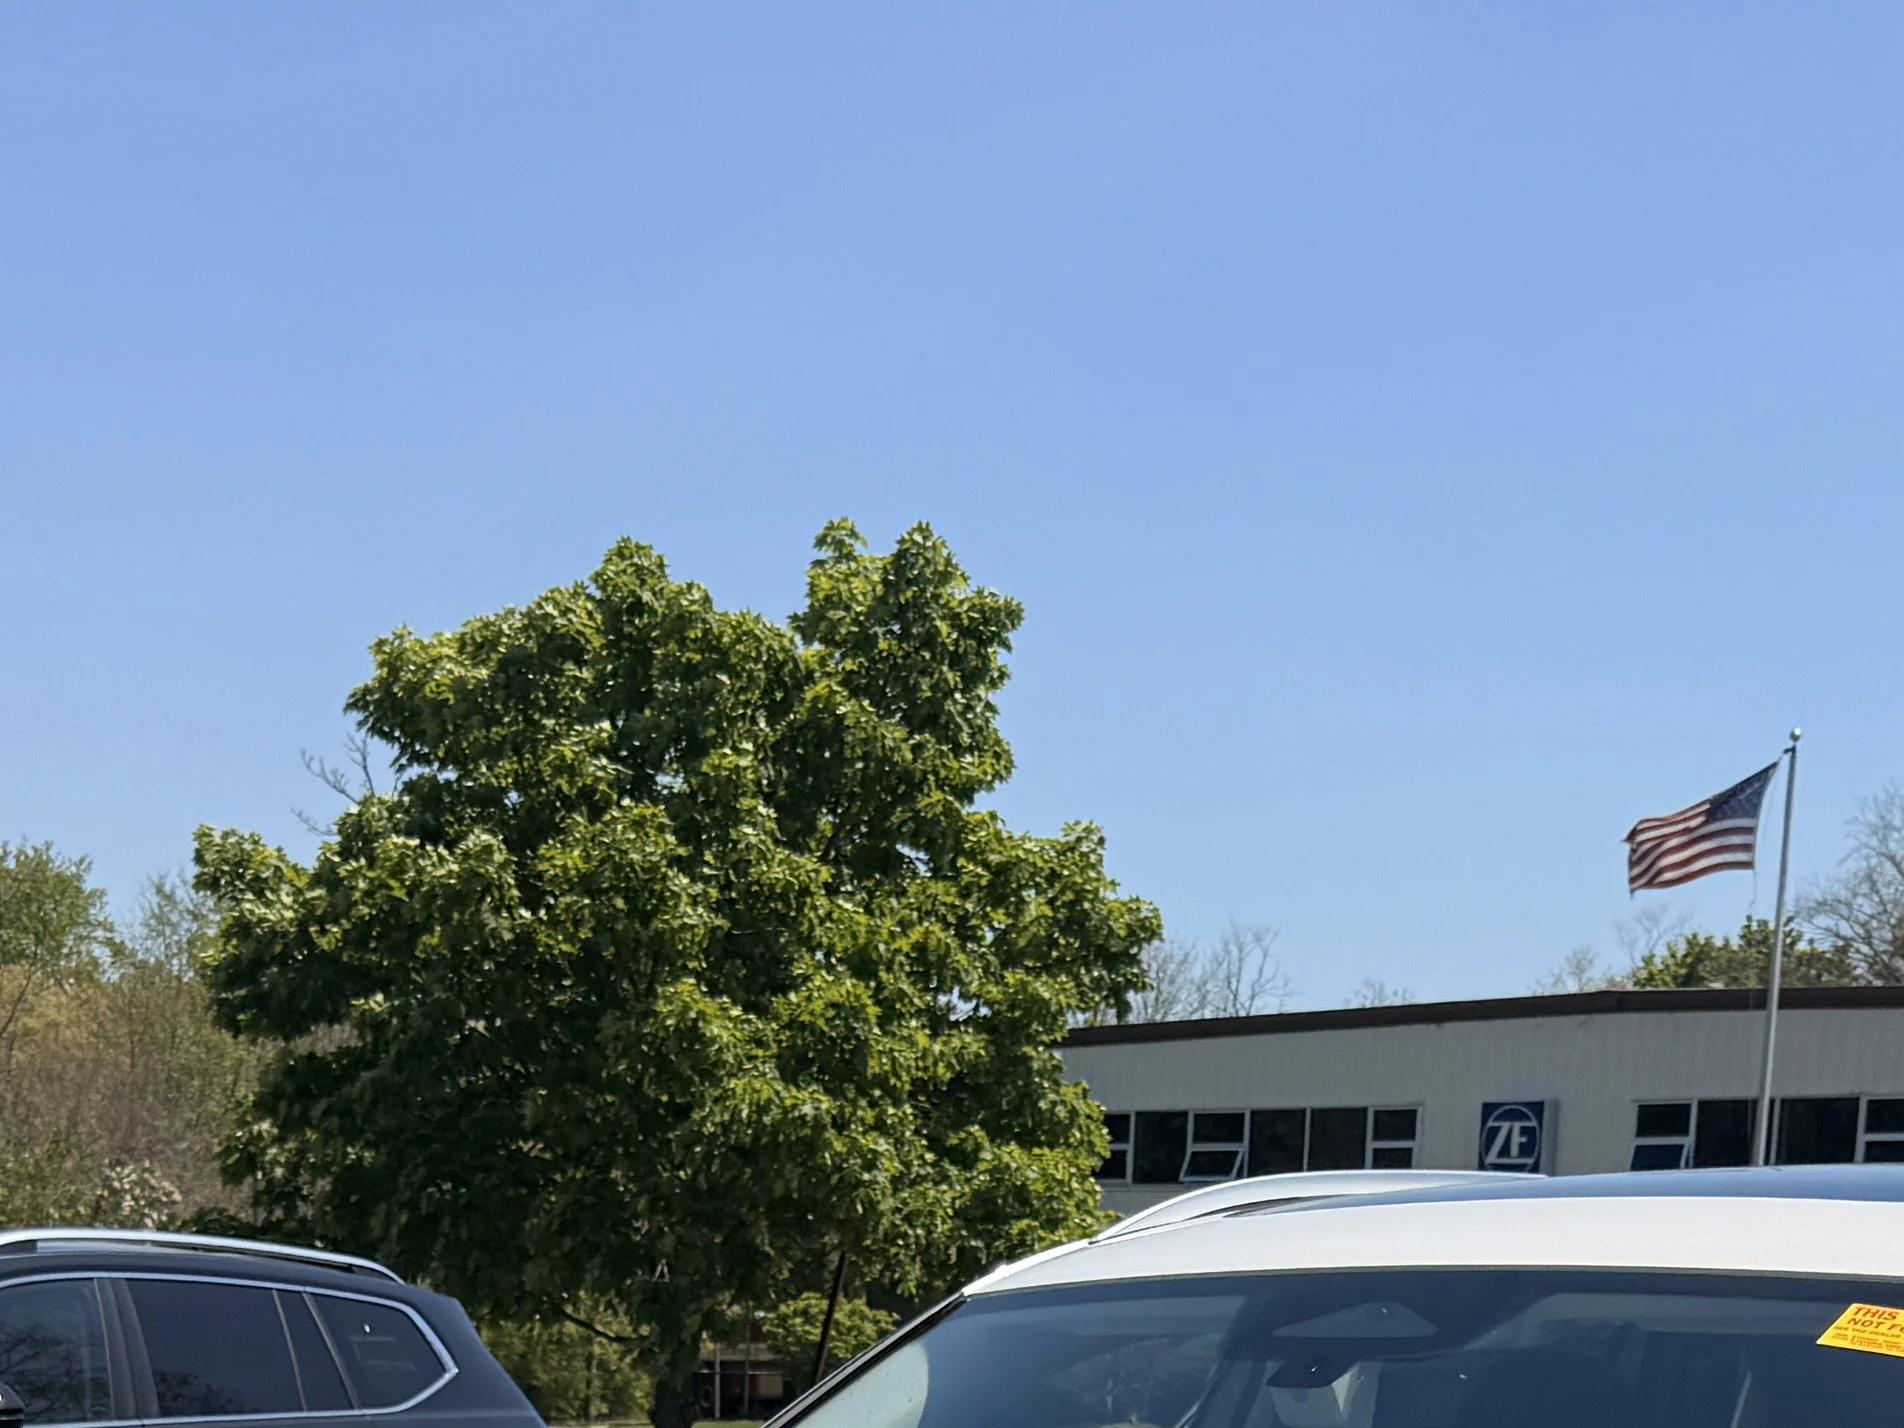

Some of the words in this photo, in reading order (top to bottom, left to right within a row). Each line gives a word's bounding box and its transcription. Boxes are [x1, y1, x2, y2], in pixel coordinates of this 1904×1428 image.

[1484, 1120, 1538, 1165] ZF
[1852, 1307, 1898, 1322] THIS
[1847, 1317, 1886, 1329] NOT
